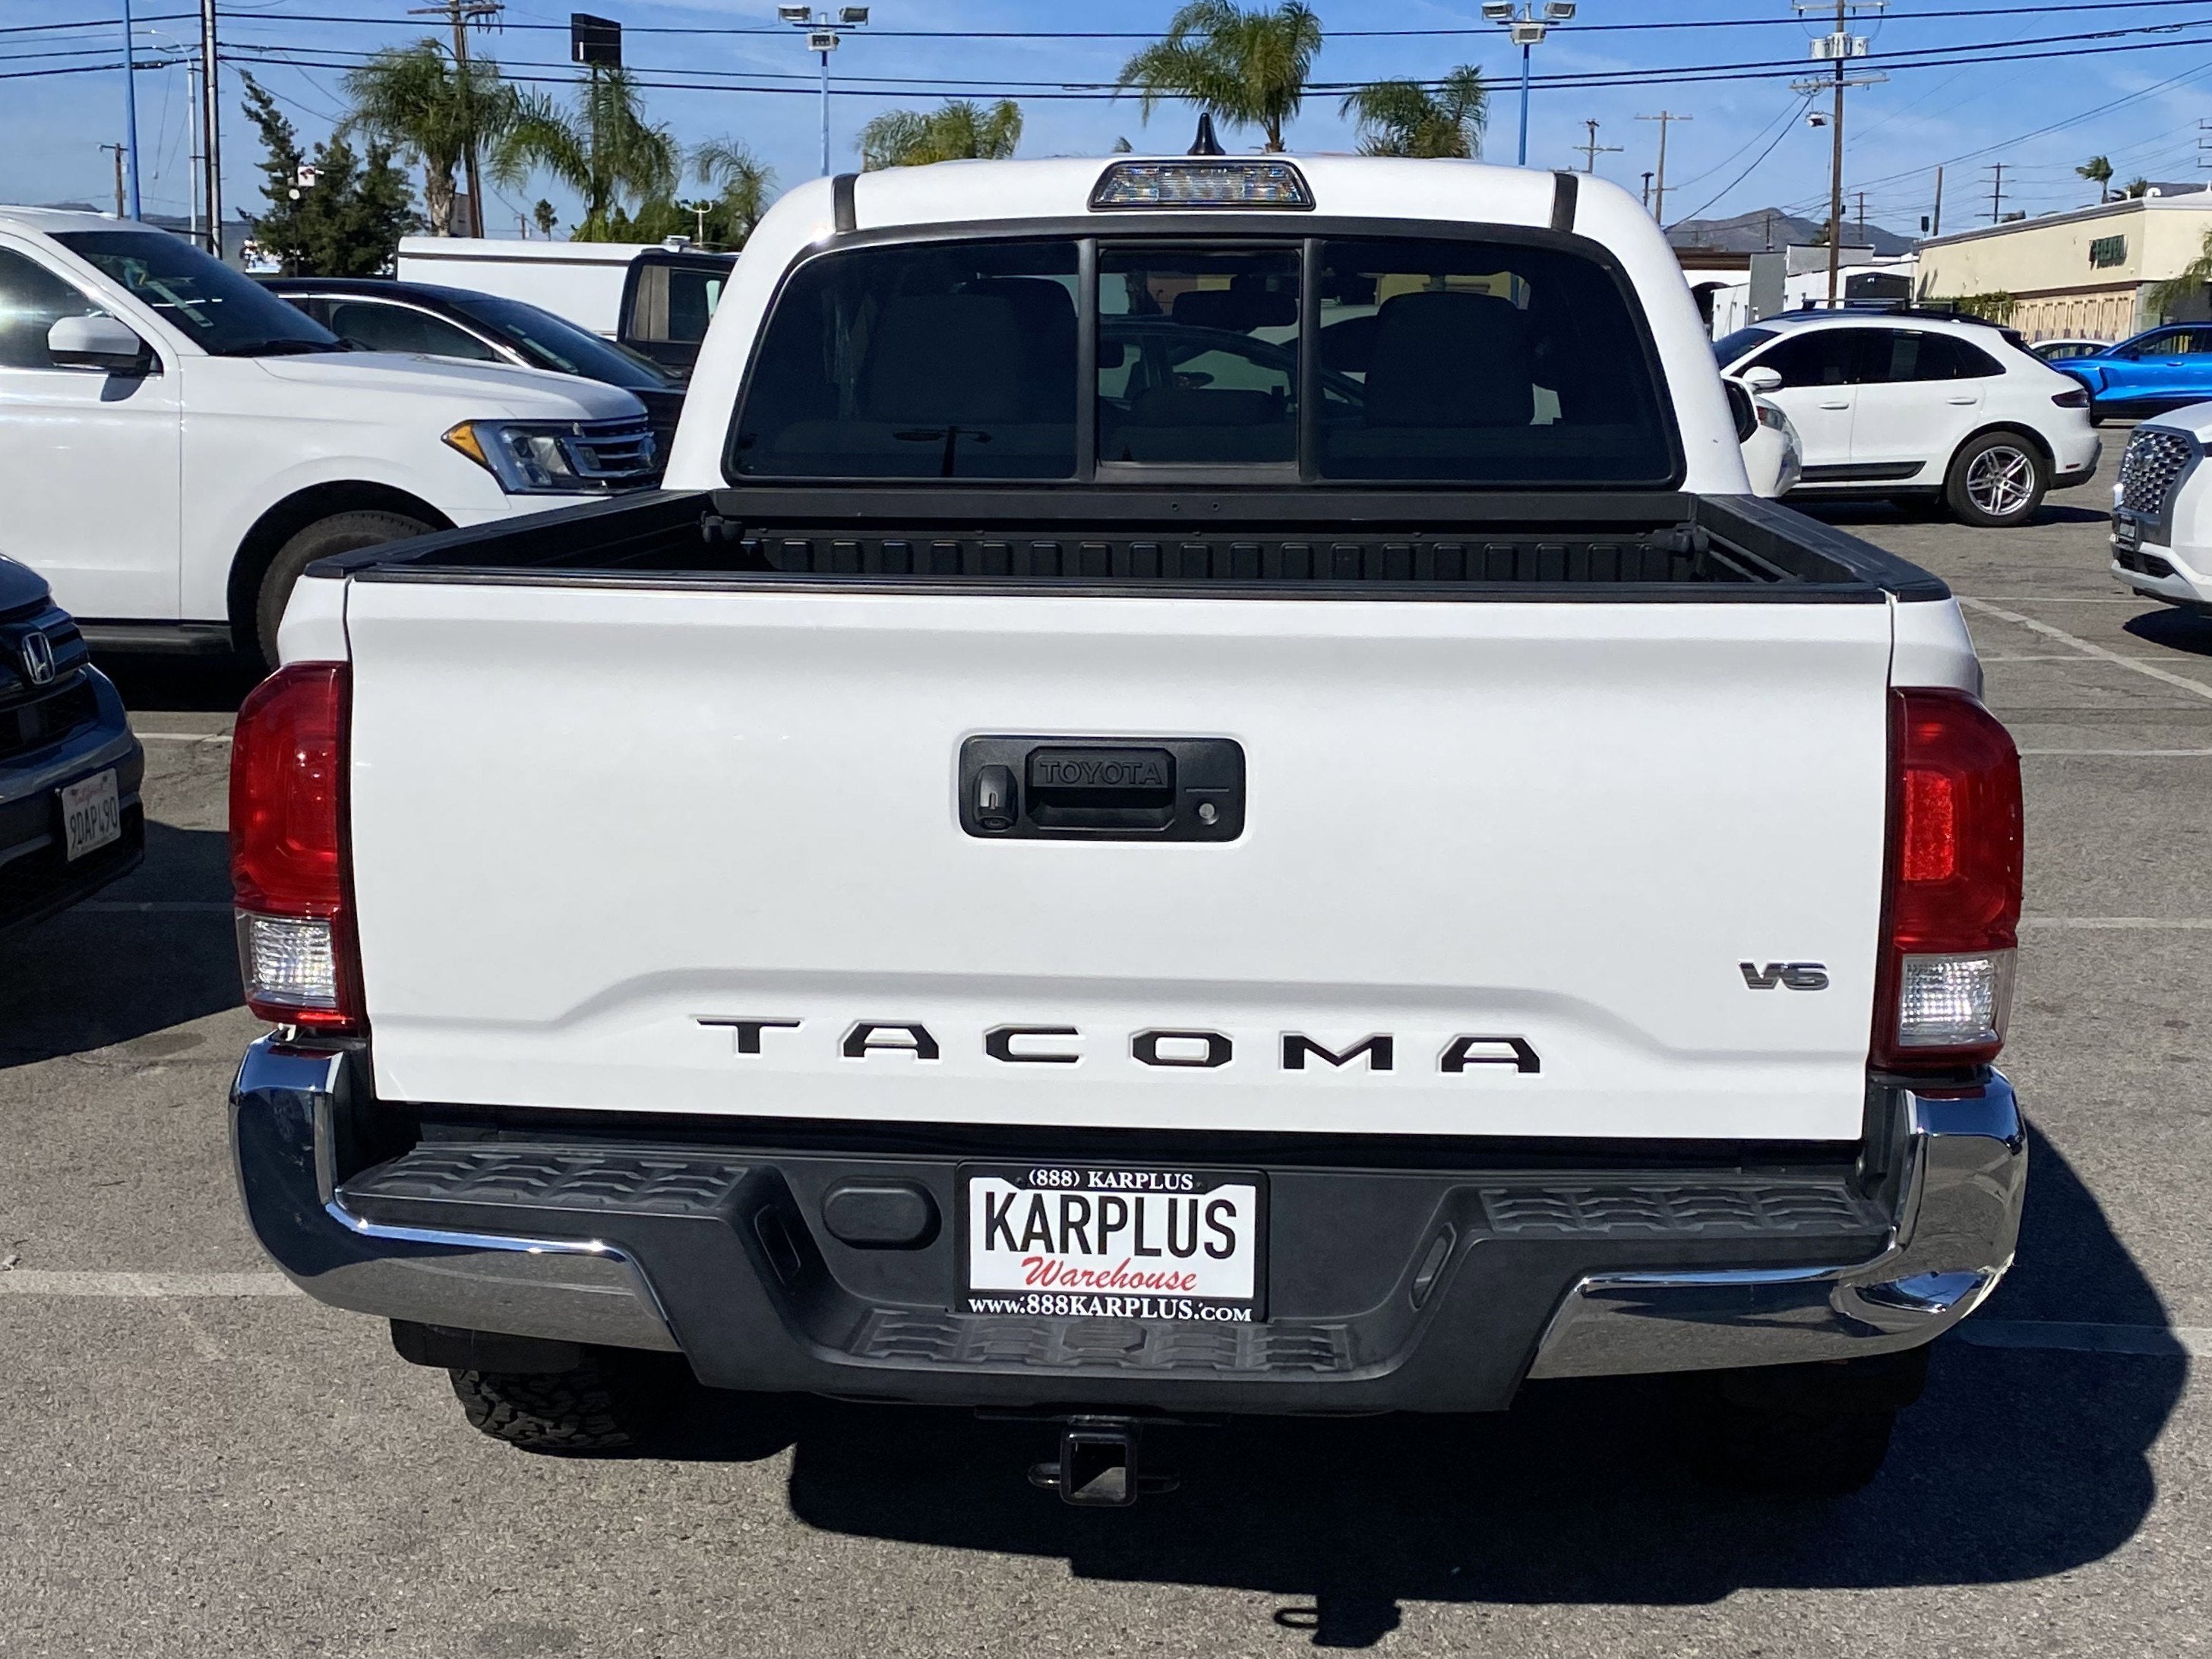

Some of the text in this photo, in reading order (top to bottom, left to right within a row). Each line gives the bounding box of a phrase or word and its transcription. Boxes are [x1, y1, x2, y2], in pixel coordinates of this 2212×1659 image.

[1040, 760, 1162, 785] TOYOTA
[1739, 962, 1829, 991] V6
[695, 1016, 1541, 1073] TACOMA
[1028, 1168, 1193, 1190] (888) KARPLUS
[985, 1191, 1237, 1259] KARPLUS
[1021, 1256, 1196, 1291] Warehouse
